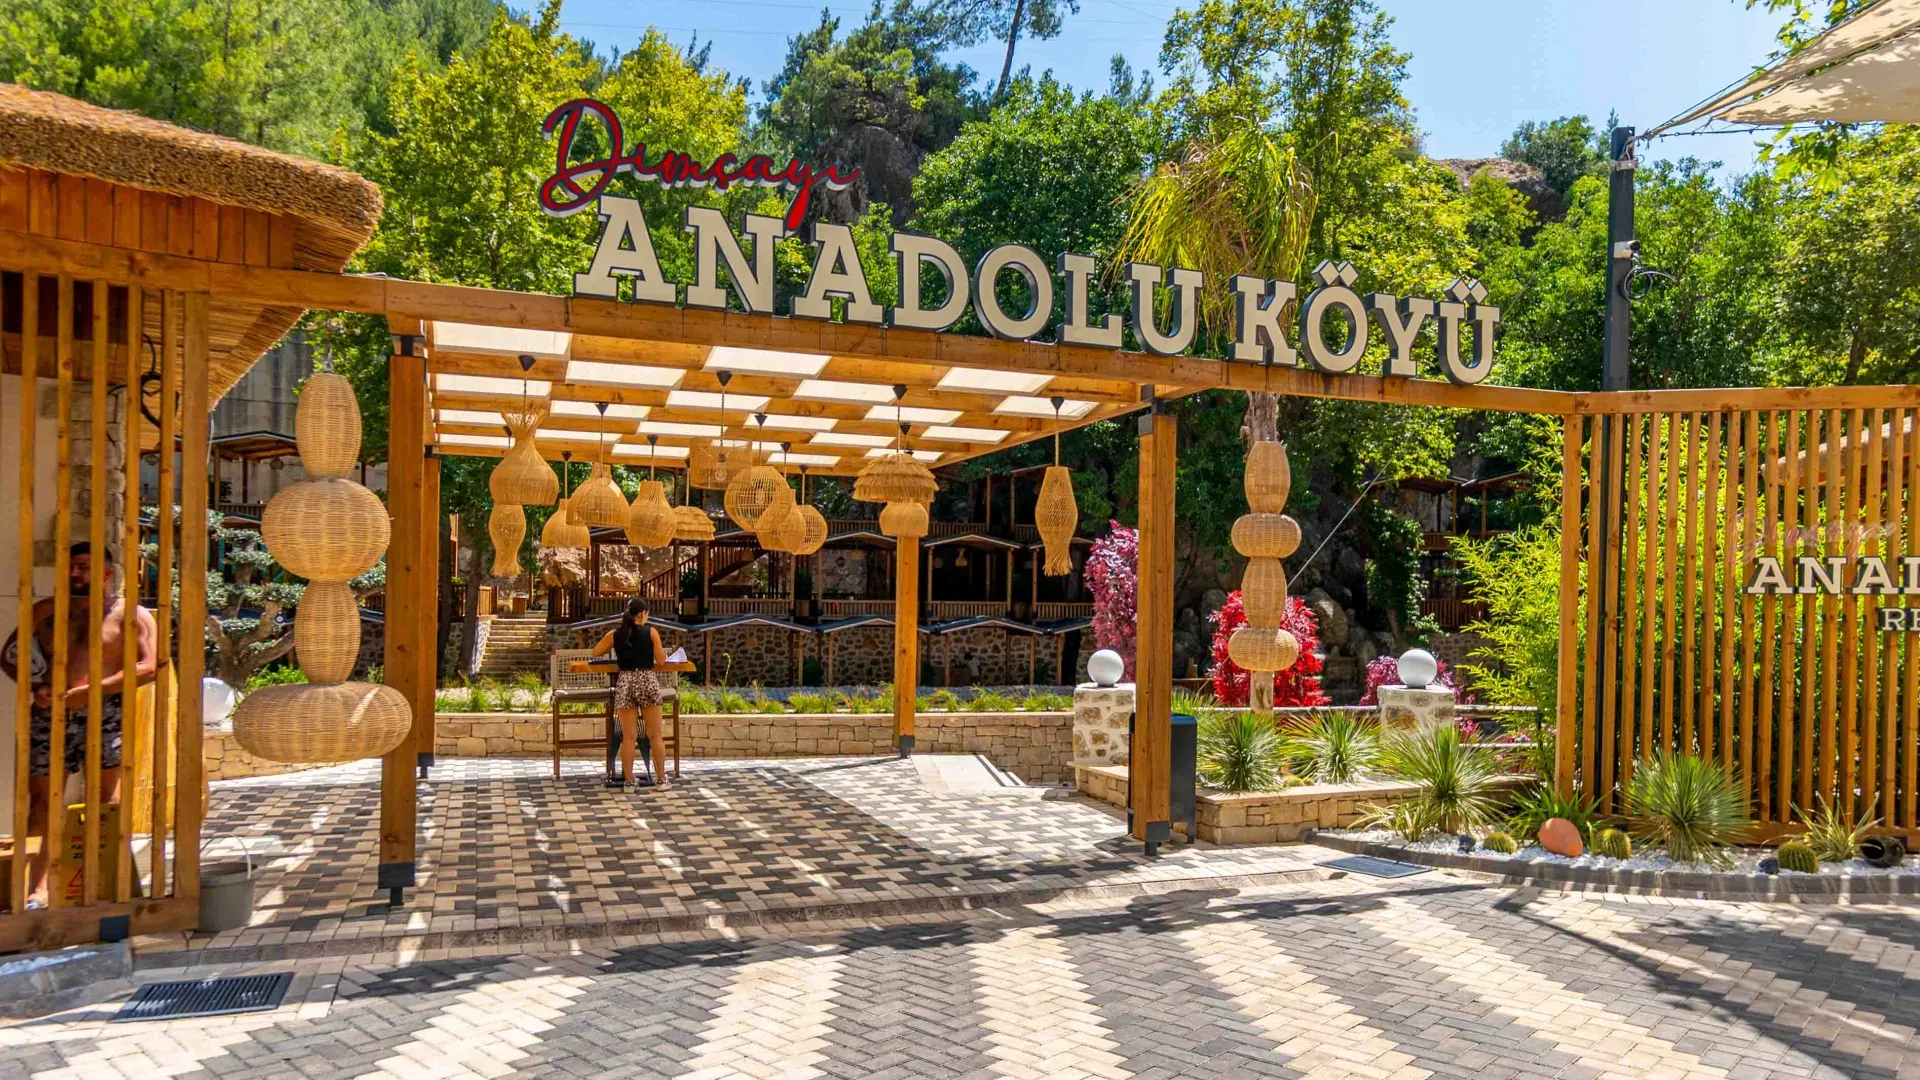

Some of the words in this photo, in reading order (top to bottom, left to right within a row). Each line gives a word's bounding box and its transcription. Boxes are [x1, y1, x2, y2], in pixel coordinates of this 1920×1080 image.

[541, 99, 861, 235] Dimçayı
[574, 195, 1203, 355] ANADOLU
[1228, 260, 1499, 384] KÖYÜ
